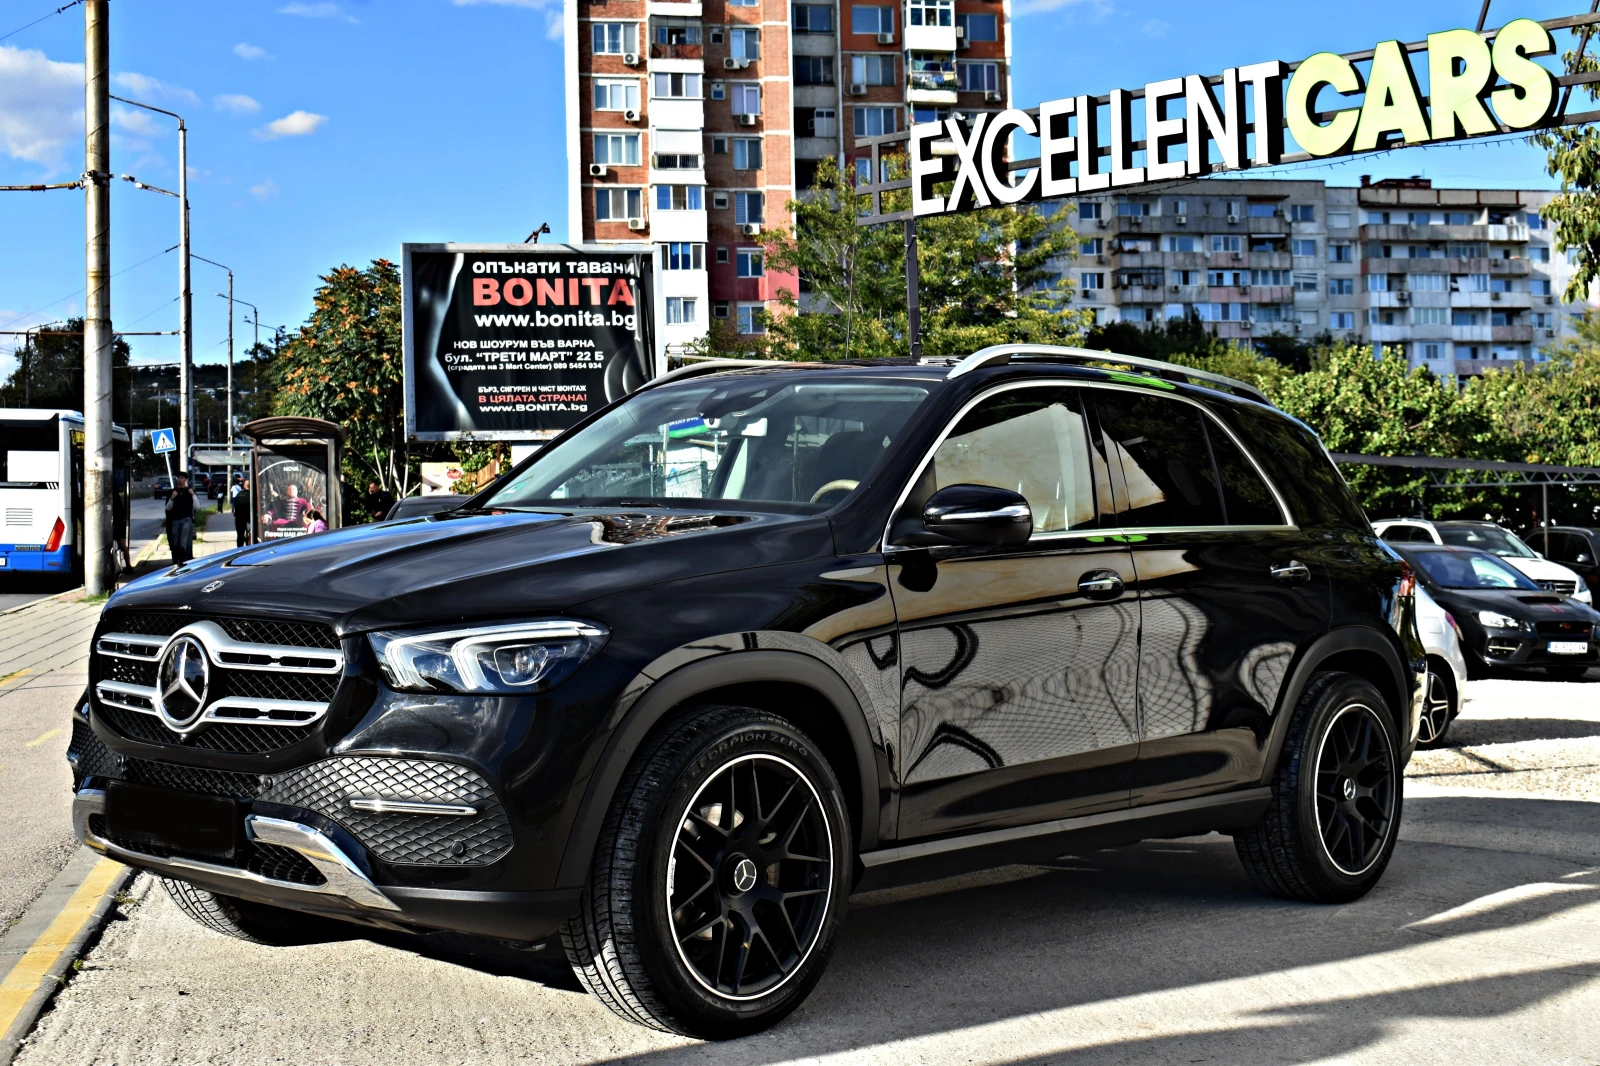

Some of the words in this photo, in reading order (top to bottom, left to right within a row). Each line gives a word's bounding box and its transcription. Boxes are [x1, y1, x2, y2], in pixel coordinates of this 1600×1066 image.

[910, 59, 1288, 217] EXCELLENT
[1285, 18, 1557, 157] CARS
[472, 261, 561, 274] опънати
[566, 261, 635, 274] тавани
[472, 277, 635, 307] BONITA
[474, 311, 637, 330] www.bonita.bg
[453, 340, 478, 349] НОВ
[480, 340, 528, 349] ШОУРУМ
[531, 340, 555, 349] ВЪВ
[557, 339, 595, 348] ВАРНА
[444, 353, 473, 364] бул.
[576, 351, 592, 361] 22
[594, 351, 604, 361] Б
[490, 395, 536, 404] ЦЯЛАТА
[538, 394, 587, 402] СТРАНА!
[479, 403, 588, 412] www.BONITA.bg
[769, 732, 808, 756] ZERO
